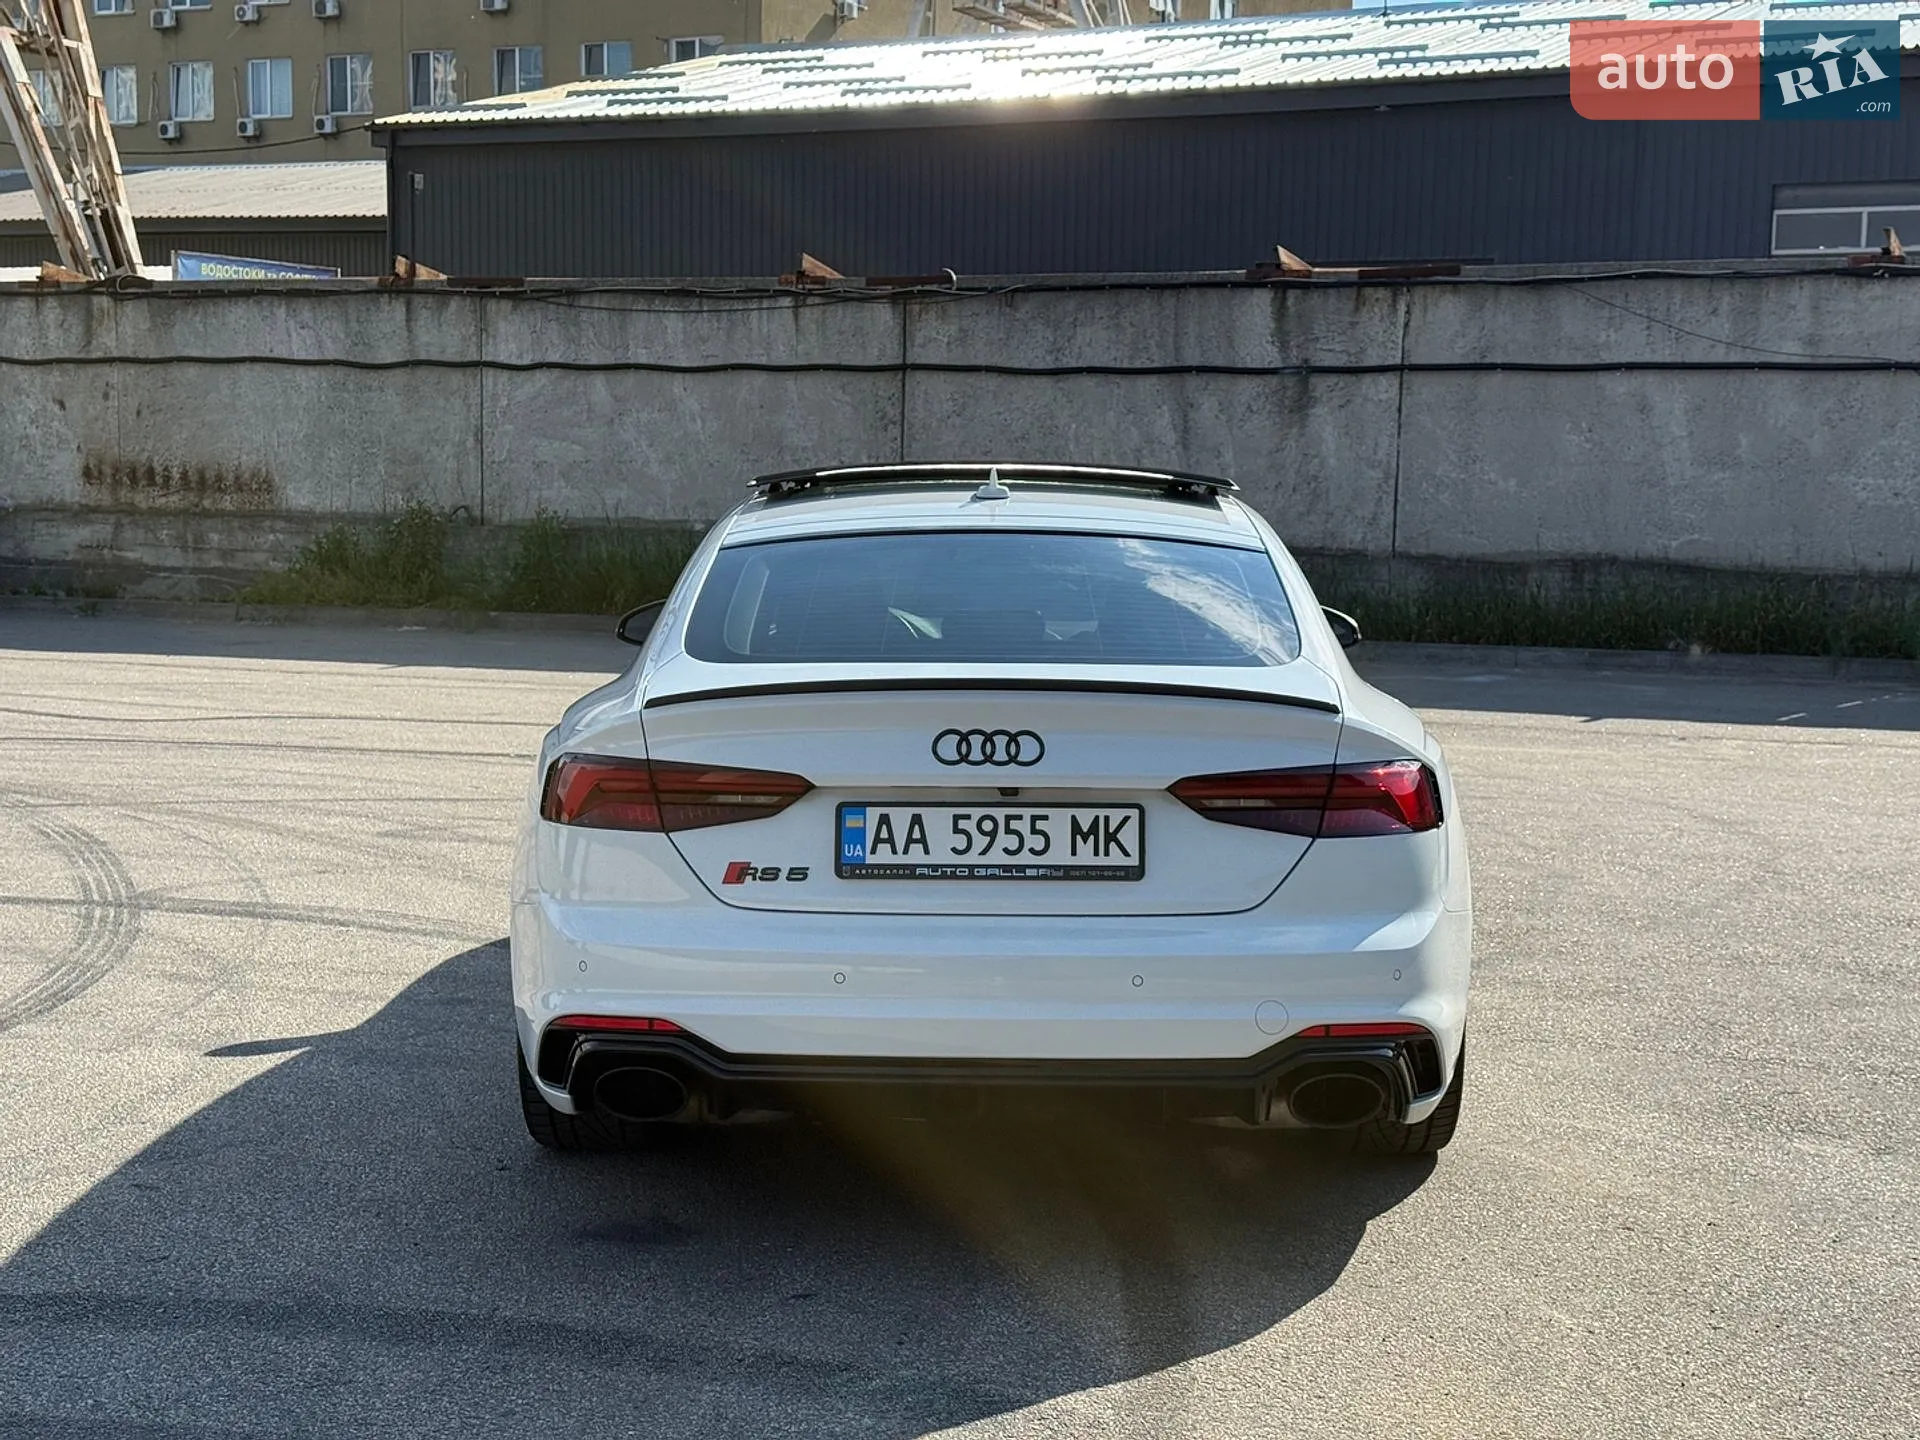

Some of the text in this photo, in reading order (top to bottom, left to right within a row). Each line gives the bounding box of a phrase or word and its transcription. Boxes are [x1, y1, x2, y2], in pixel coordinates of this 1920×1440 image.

[201, 263, 265, 279] ВОДОСТОКИ
[869, 813, 1132, 857] AA 5955 MK
[844, 844, 863, 857] UA
[734, 866, 810, 882] RS 5
[916, 867, 969, 876] AUTO
[974, 867, 1064, 877] GALLERY
